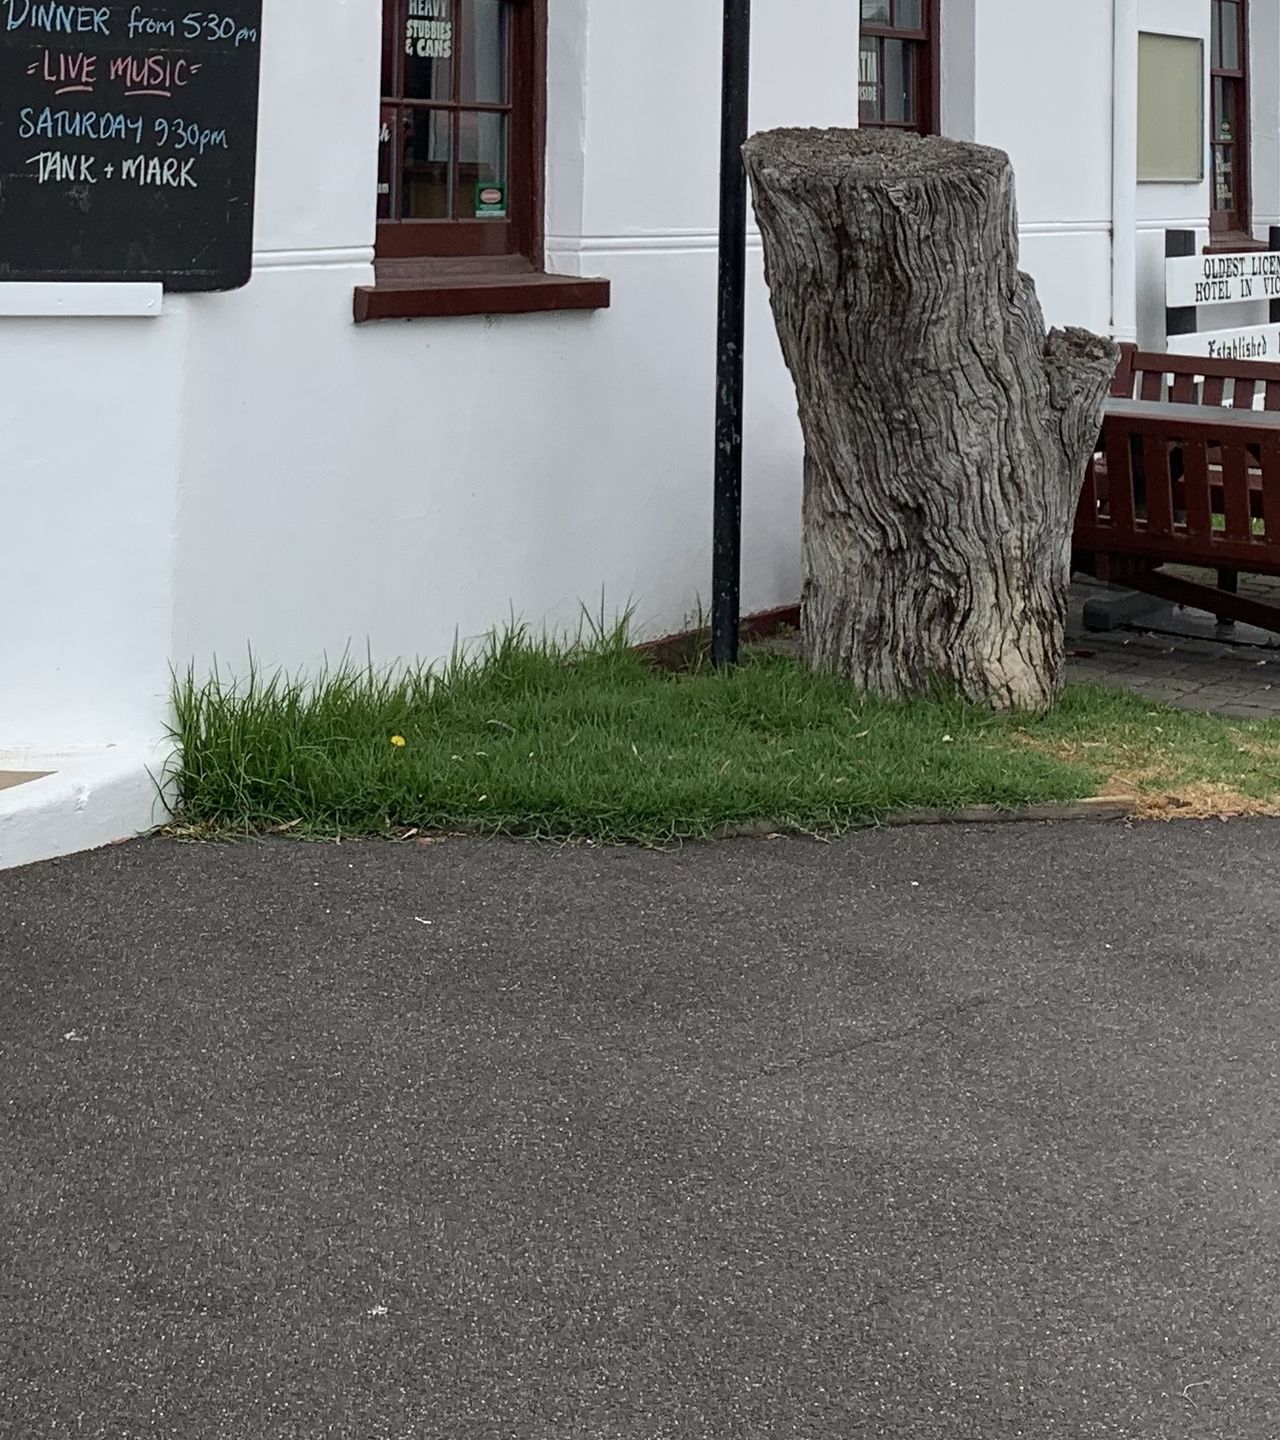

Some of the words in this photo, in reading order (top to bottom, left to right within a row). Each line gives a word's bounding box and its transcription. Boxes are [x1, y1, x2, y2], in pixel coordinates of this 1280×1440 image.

[127, 6, 175, 39] from
[405, 19, 452, 40] STUBBIES
[416, 38, 452, 58] CANS
[43, 49, 97, 83] LIVE
[109, 54, 188, 89] MUSIC
[19, 106, 144, 144] SATURDAY
[25, 151, 98, 184] TANK
[103, 163, 114, 179] +
[121, 154, 197, 188] MARK
[1203, 257, 1246, 280] OLDEST
[1195, 280, 1231, 302] HOTEL
[1240, 278, 1252, 298] IN
[1208, 334, 1267, 359] Established
